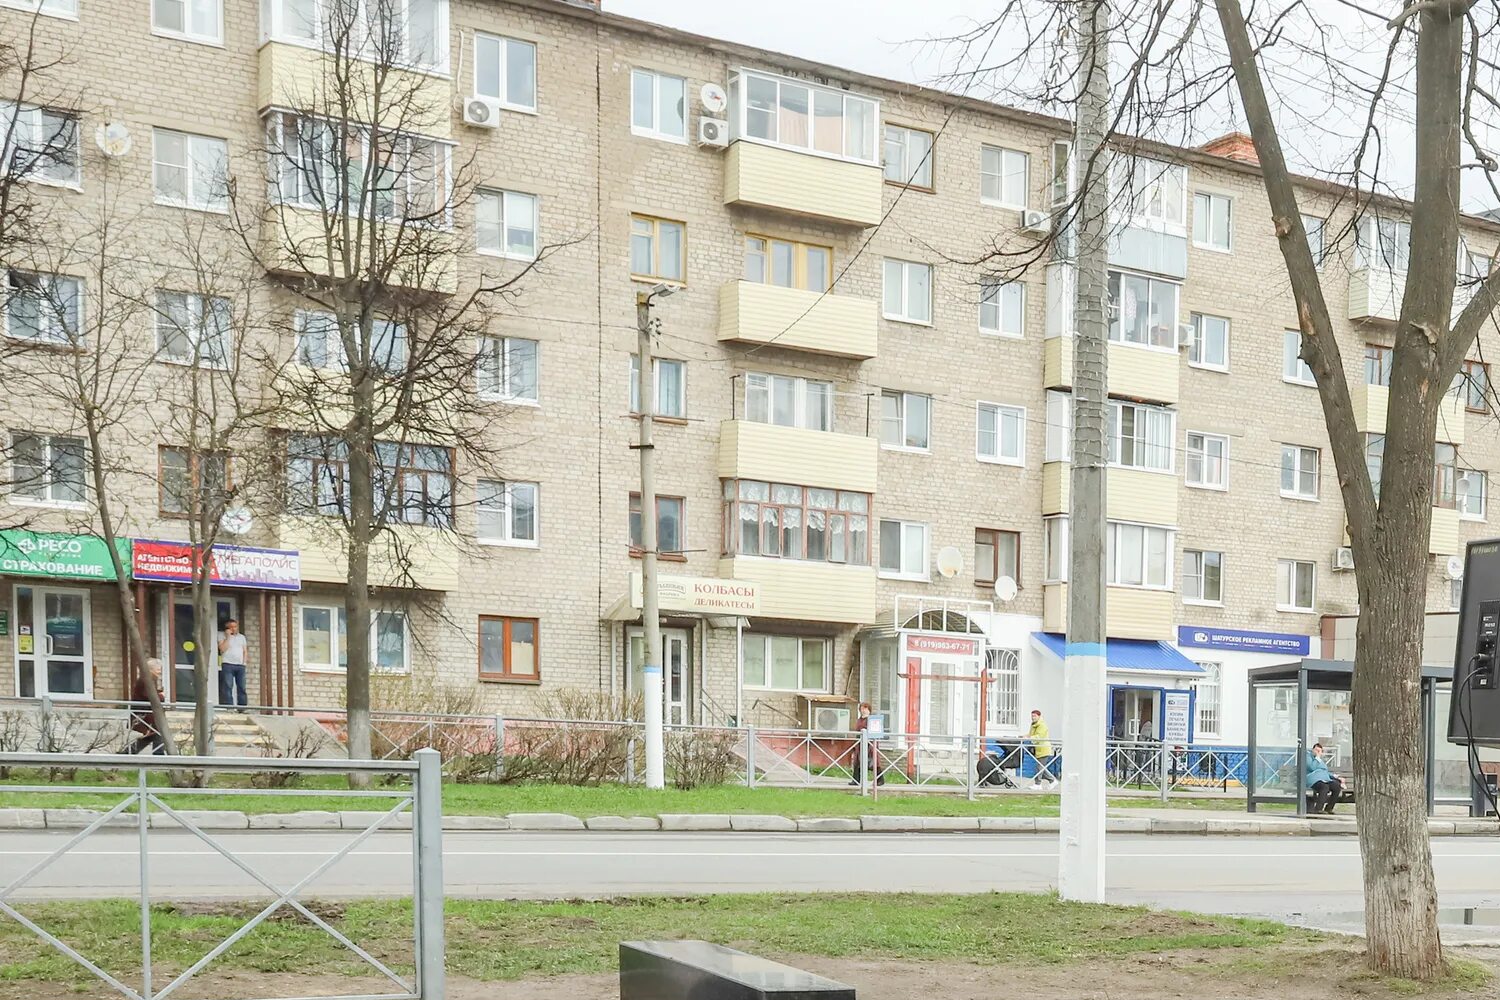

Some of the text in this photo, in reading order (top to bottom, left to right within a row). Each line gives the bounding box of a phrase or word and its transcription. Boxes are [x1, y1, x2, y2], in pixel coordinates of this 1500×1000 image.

[38, 538, 82, 553] РЕСО
[3, 560, 104, 576] СТРАХОВАНИЕ
[218, 554, 297, 570] МЕГАПОЛИС
[694, 583, 755, 597] КОЛБАСЫ
[694, 598, 755, 609] ДЕЛИКАТЕСЫ
